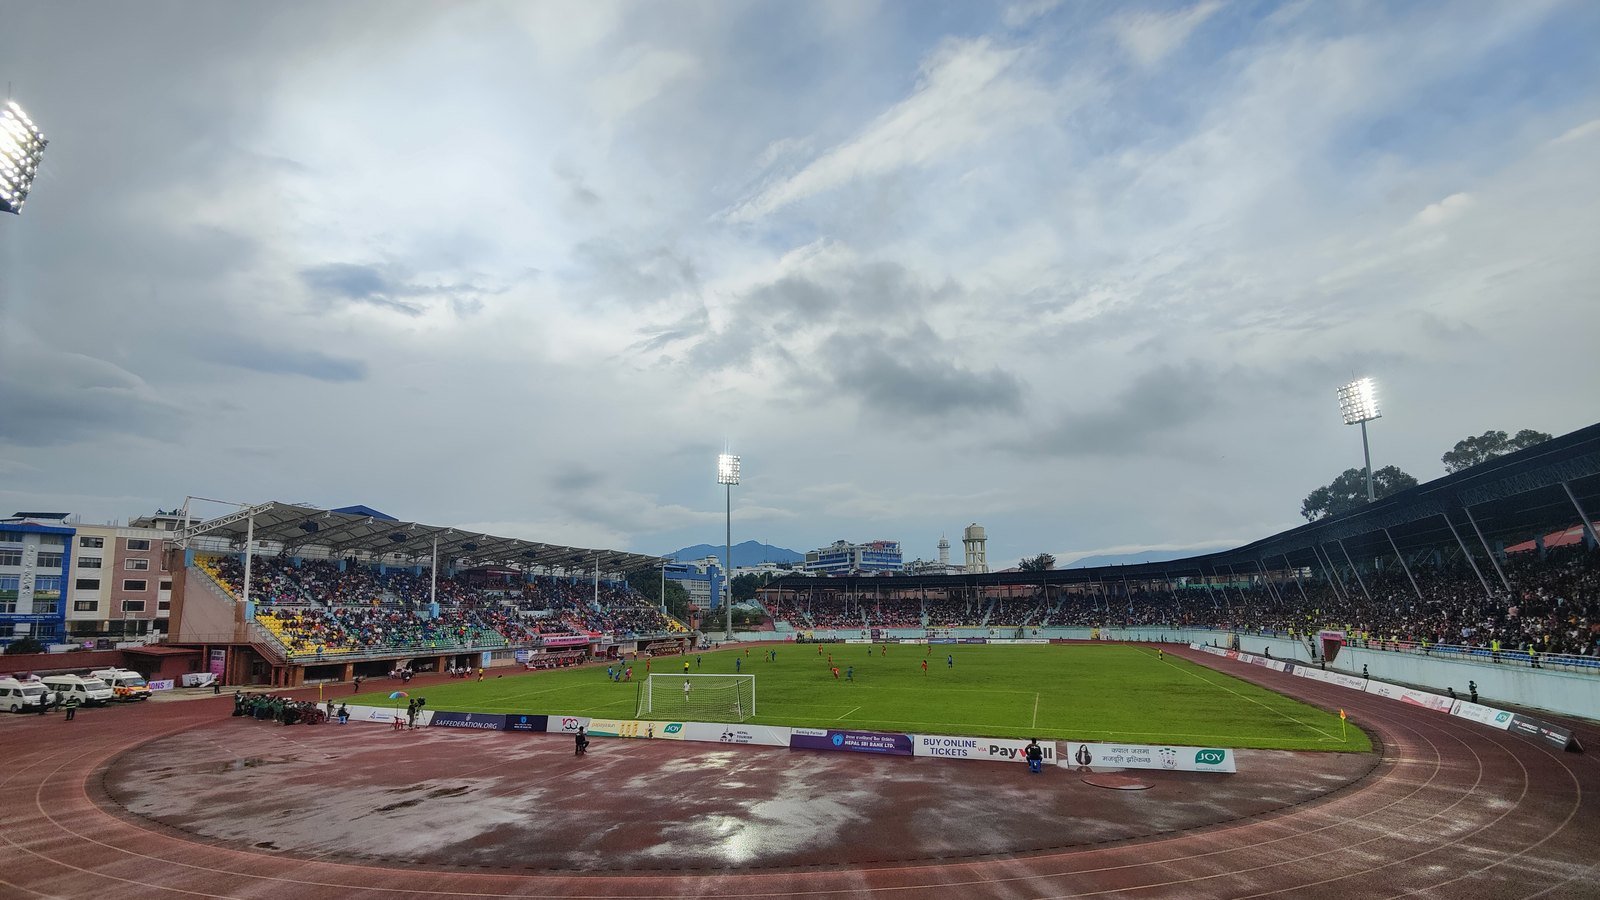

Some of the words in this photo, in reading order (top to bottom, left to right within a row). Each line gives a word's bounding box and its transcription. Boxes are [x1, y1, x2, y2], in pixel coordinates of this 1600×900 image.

[435, 719, 498, 729] SAFFEDERATION.ORG
[943, 739, 976, 748] ONLINE
[930, 748, 968, 756] TICKETS
[990, 745, 1052, 759] Payll
[1198, 753, 1222, 761] JOY
